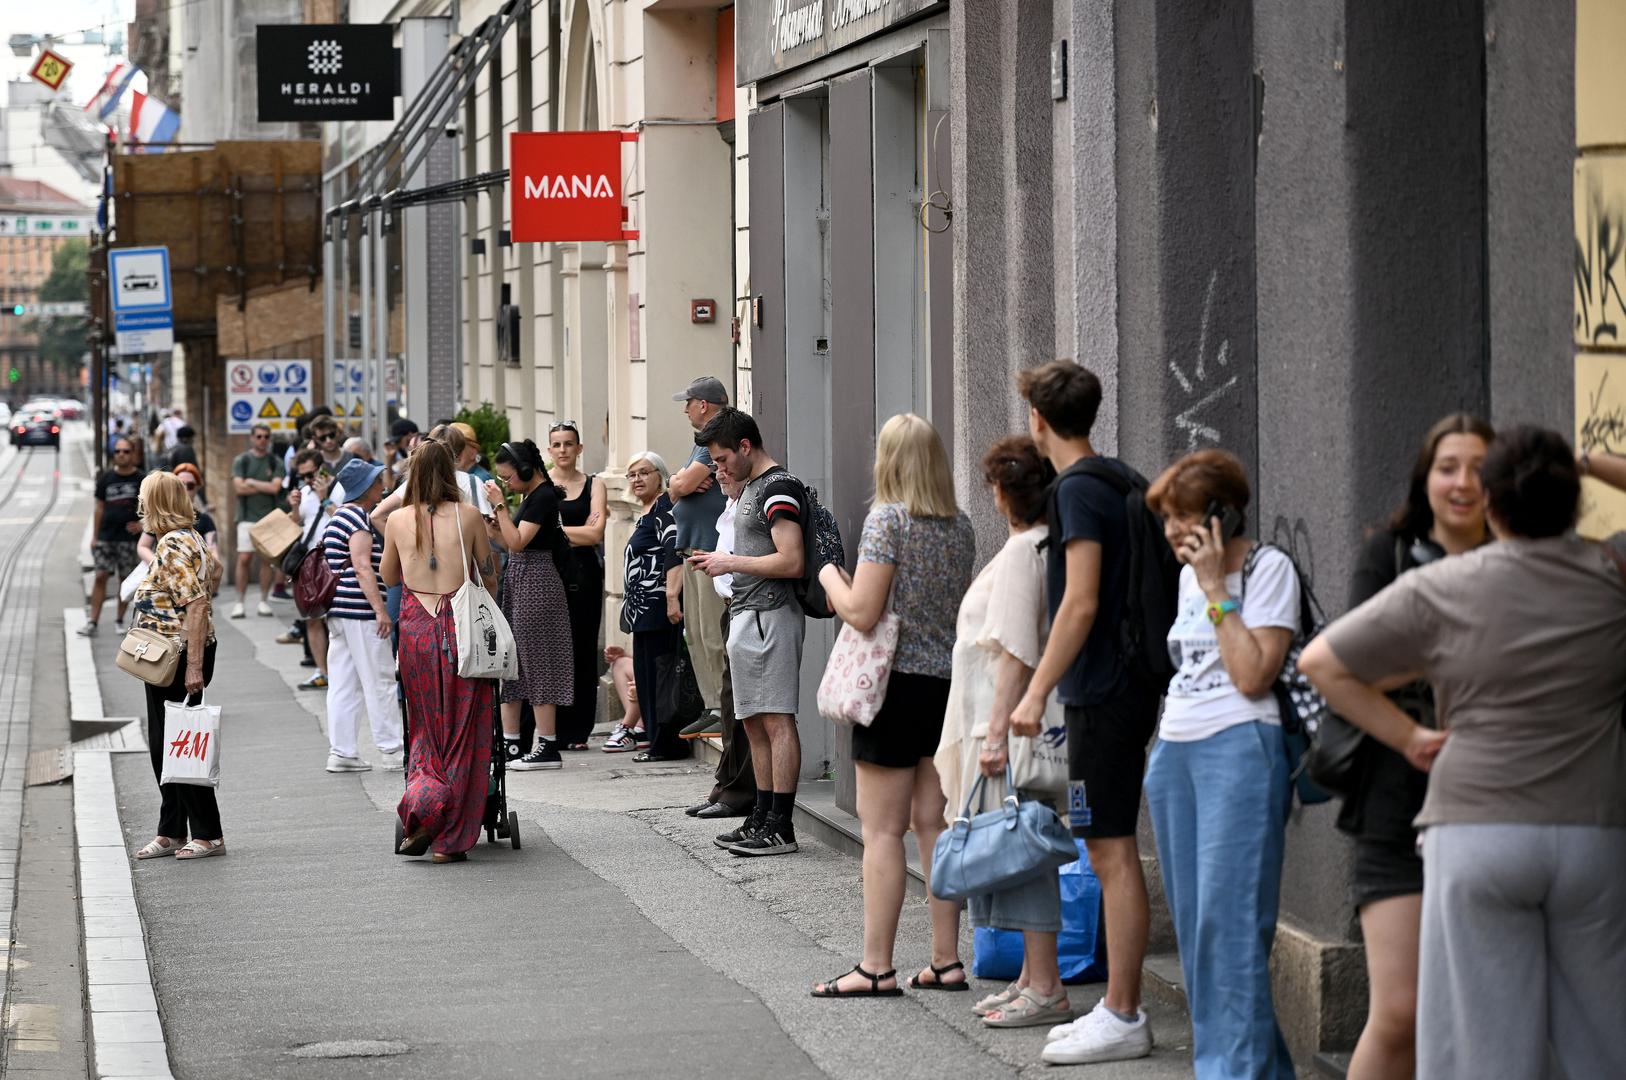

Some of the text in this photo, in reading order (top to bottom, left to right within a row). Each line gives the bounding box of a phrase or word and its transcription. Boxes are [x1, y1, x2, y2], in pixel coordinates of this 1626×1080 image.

[281, 82, 371, 95] HERALDI
[524, 174, 614, 199] MANA
[169, 729, 210, 762] H&M
